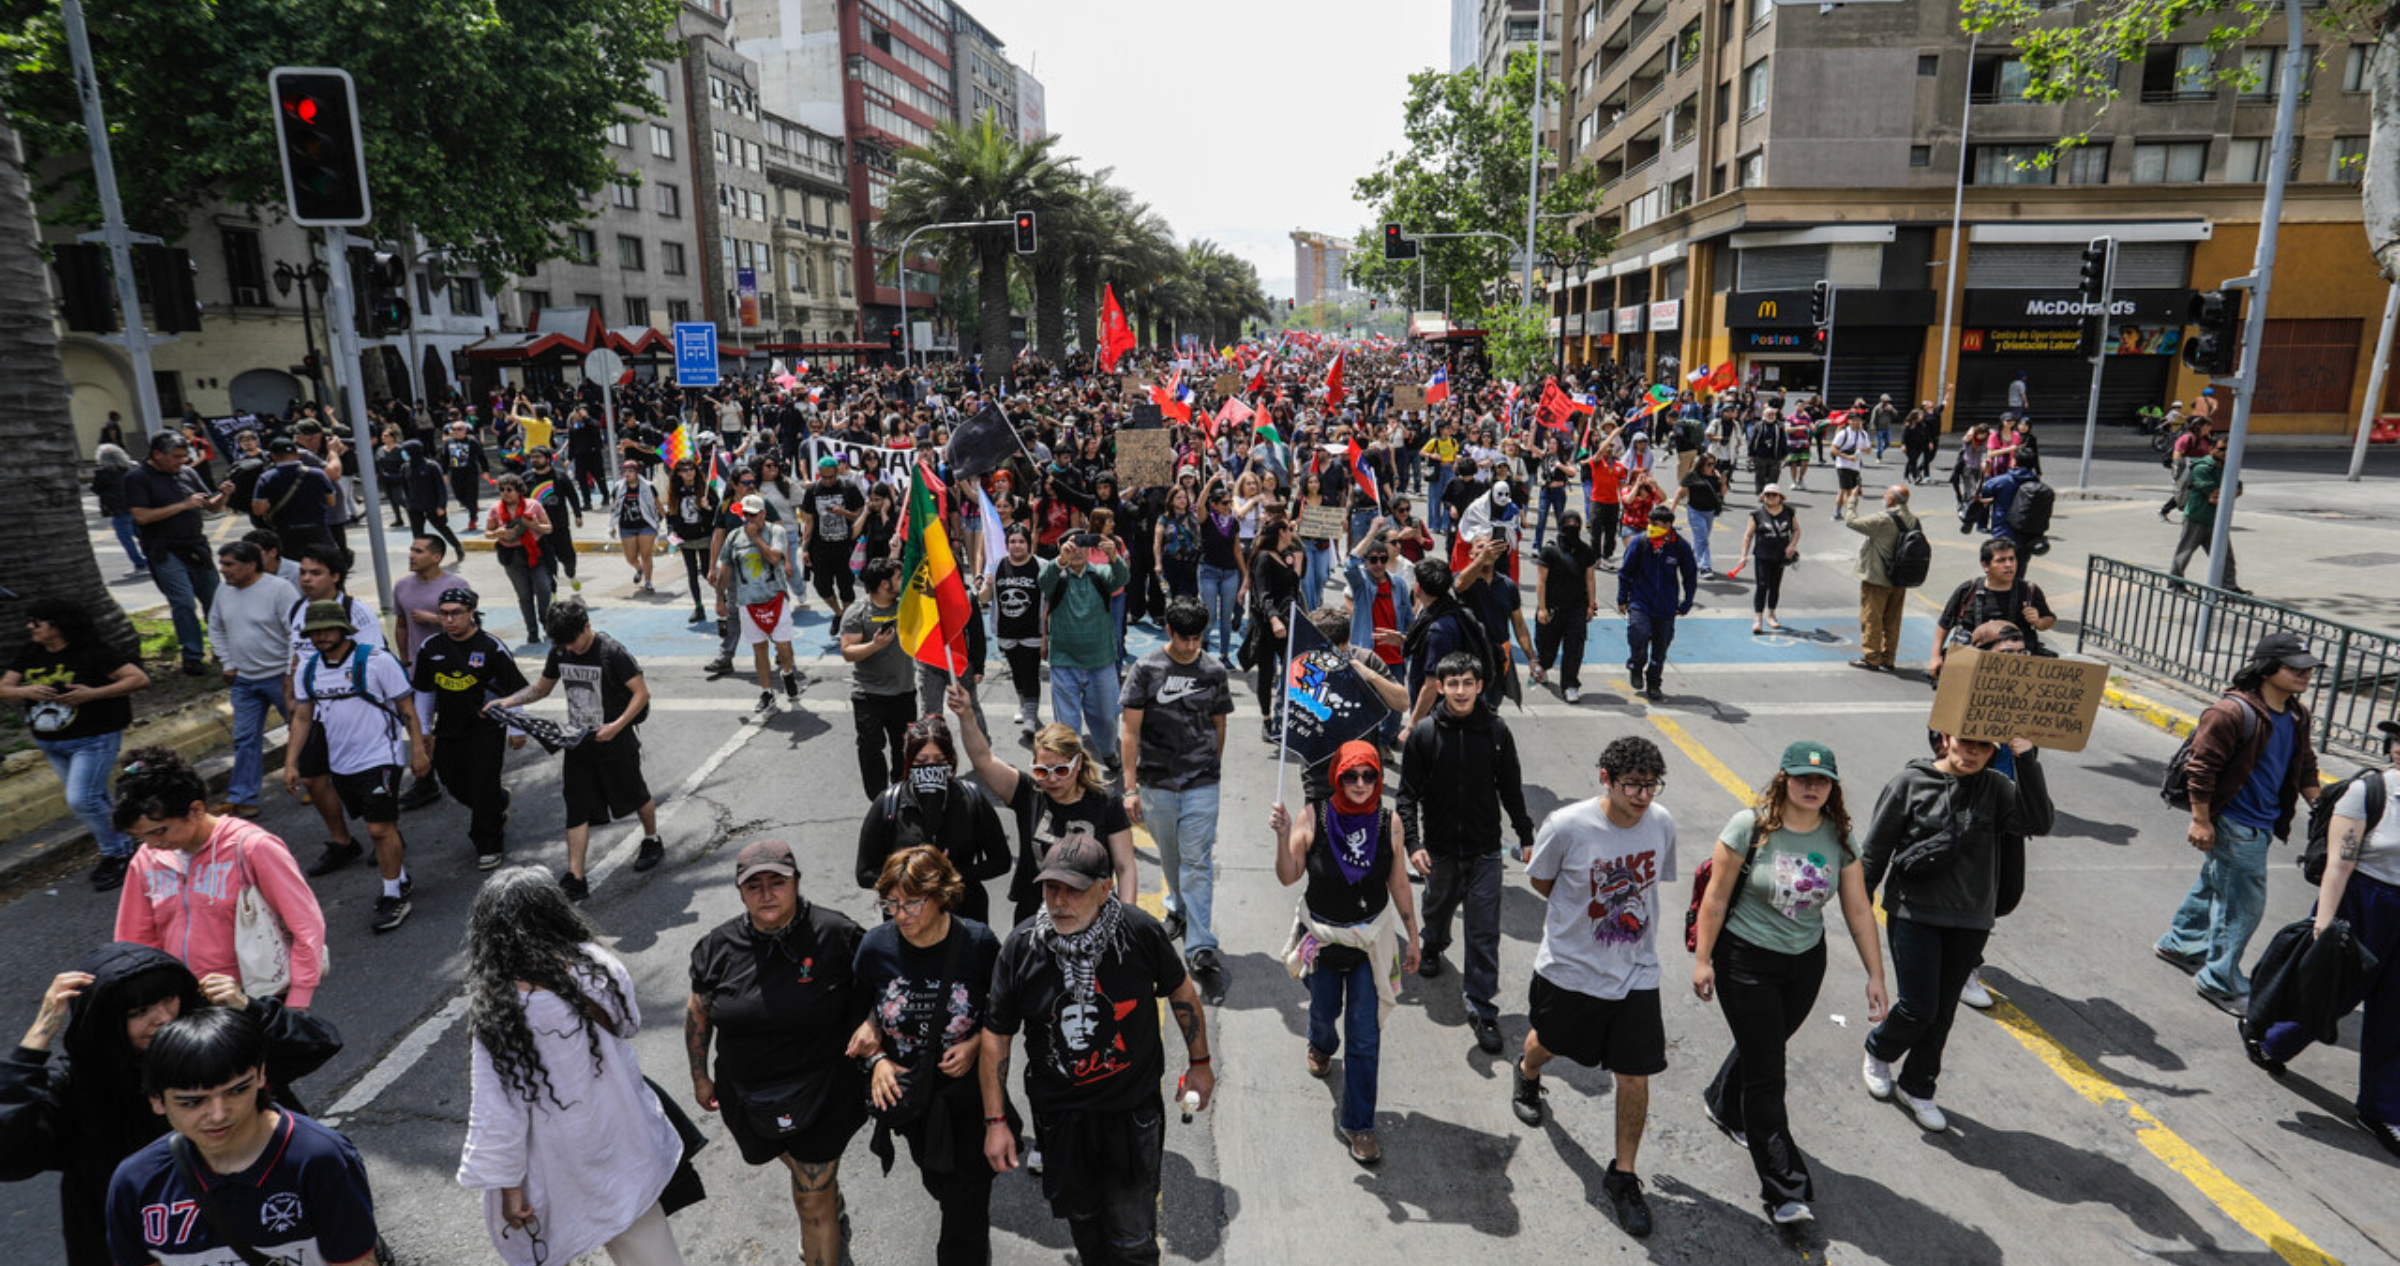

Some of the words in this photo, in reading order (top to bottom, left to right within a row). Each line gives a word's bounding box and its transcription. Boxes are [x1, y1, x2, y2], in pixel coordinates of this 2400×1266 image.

[1751, 334, 1800, 346] Postres
[1979, 655, 2006, 675] HAY
[2007, 659, 2033, 677] QUE
[1163, 676, 1197, 692] NIKE
[1974, 675, 2018, 696] LUCHAR
[2023, 683, 2036, 696] Y
[2036, 683, 2084, 702] SEGUIR
[2032, 700, 2080, 716] AUNQUE
[1961, 723, 1977, 735] LA
[1966, 708, 1987, 721] EN
[1988, 710, 2011, 724] ELLO
[2014, 713, 2030, 726] SE
[2030, 716, 2053, 727] NOS
[2054, 718, 2083, 733] VAYA
[142, 1200, 200, 1245] 07
